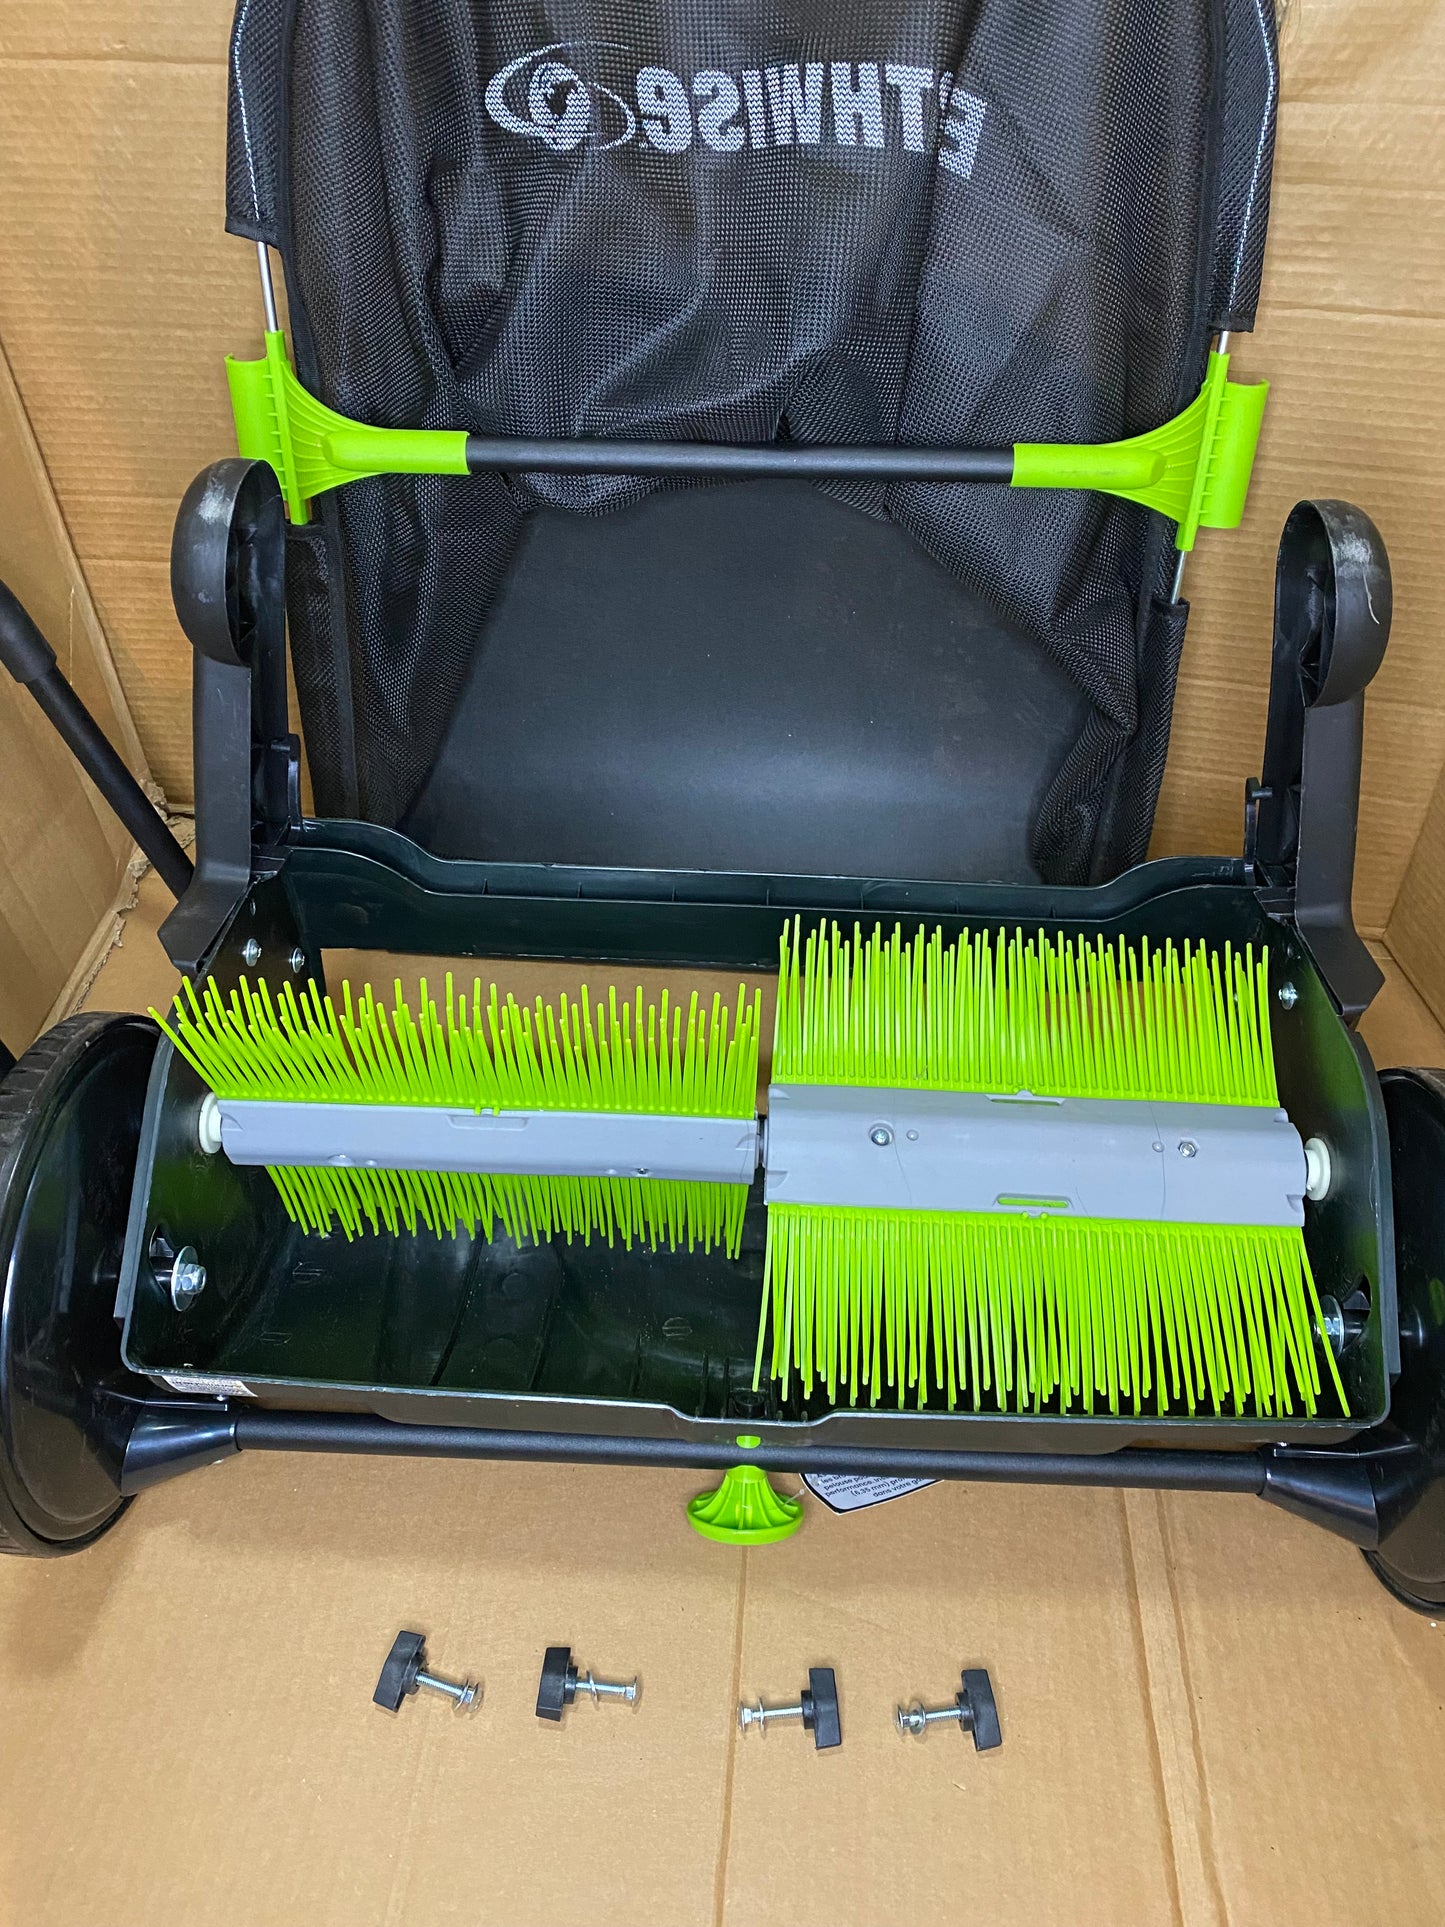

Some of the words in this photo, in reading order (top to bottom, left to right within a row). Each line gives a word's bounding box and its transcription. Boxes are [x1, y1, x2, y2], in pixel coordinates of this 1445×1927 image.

[824, 1479, 853, 1490] pelouse
[871, 1481, 890, 1490] mm)
[873, 1489, 892, 1497] dans
[891, 1482, 912, 1491] votre
